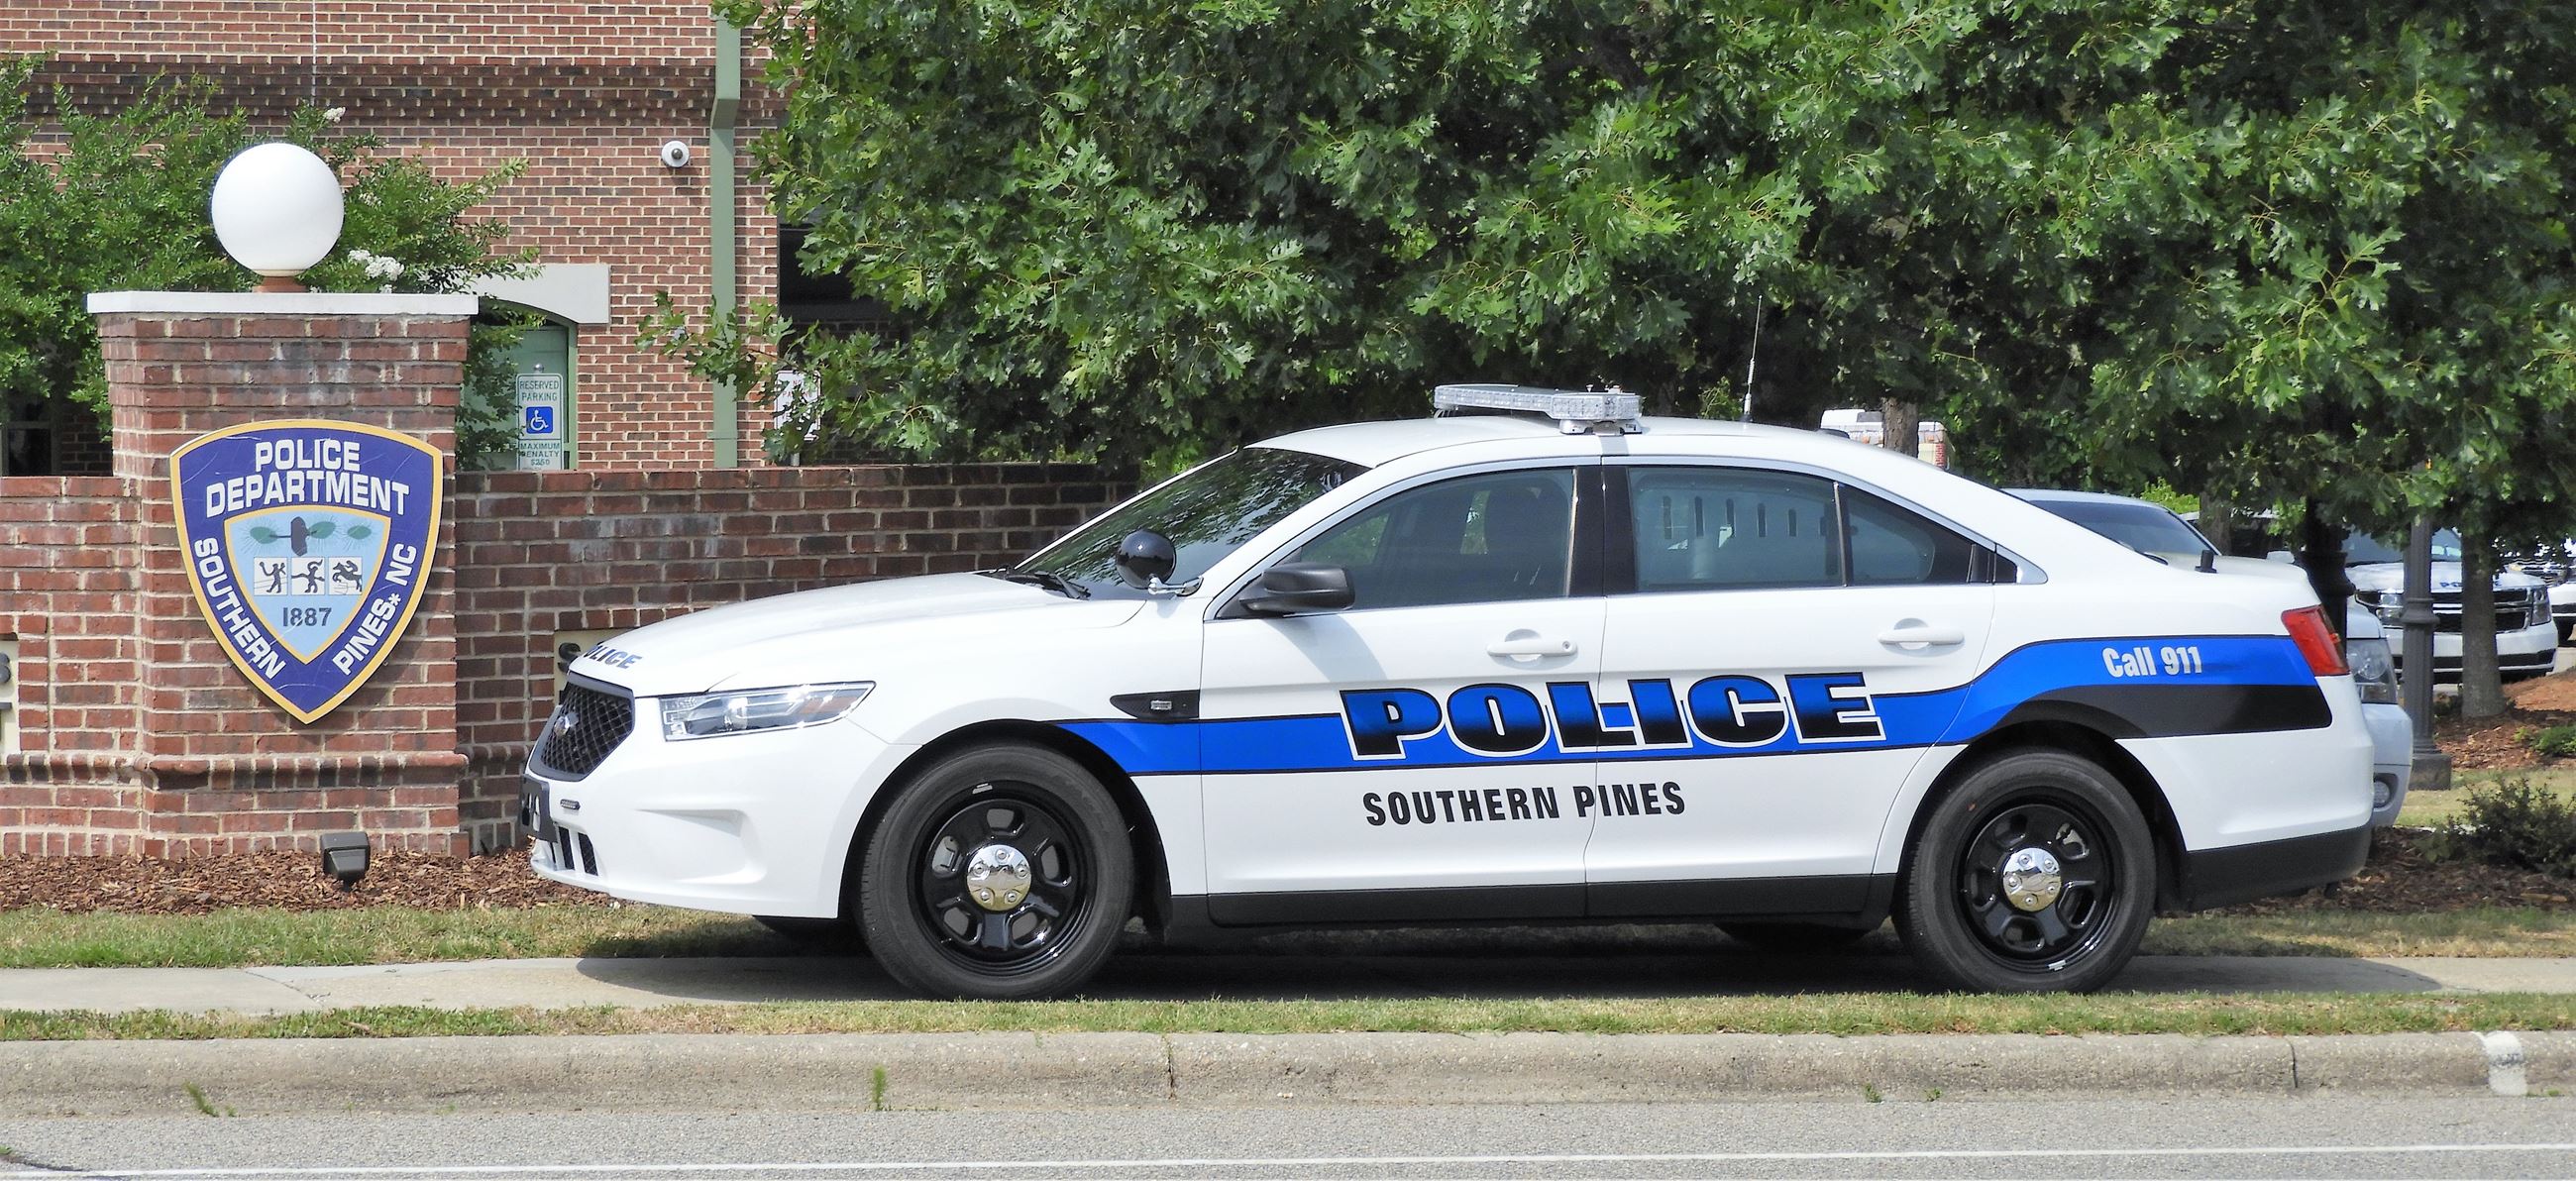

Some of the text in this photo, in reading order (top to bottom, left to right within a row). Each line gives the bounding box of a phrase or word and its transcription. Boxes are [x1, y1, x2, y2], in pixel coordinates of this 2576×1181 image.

[519, 380, 560, 390] RESERVED
[521, 392, 558, 401] PARKING
[255, 439, 361, 473] POLICE
[206, 470, 410, 519] DEPARTMENT
[385, 543, 417, 587] NC
[194, 537, 287, 680] SOUTHERN
[282, 606, 332, 627] 1887
[2101, 646, 2202, 678] Call 911
[1340, 671, 1887, 762] POLICE
[1362, 780, 1686, 827] SOUTHERN PINES
